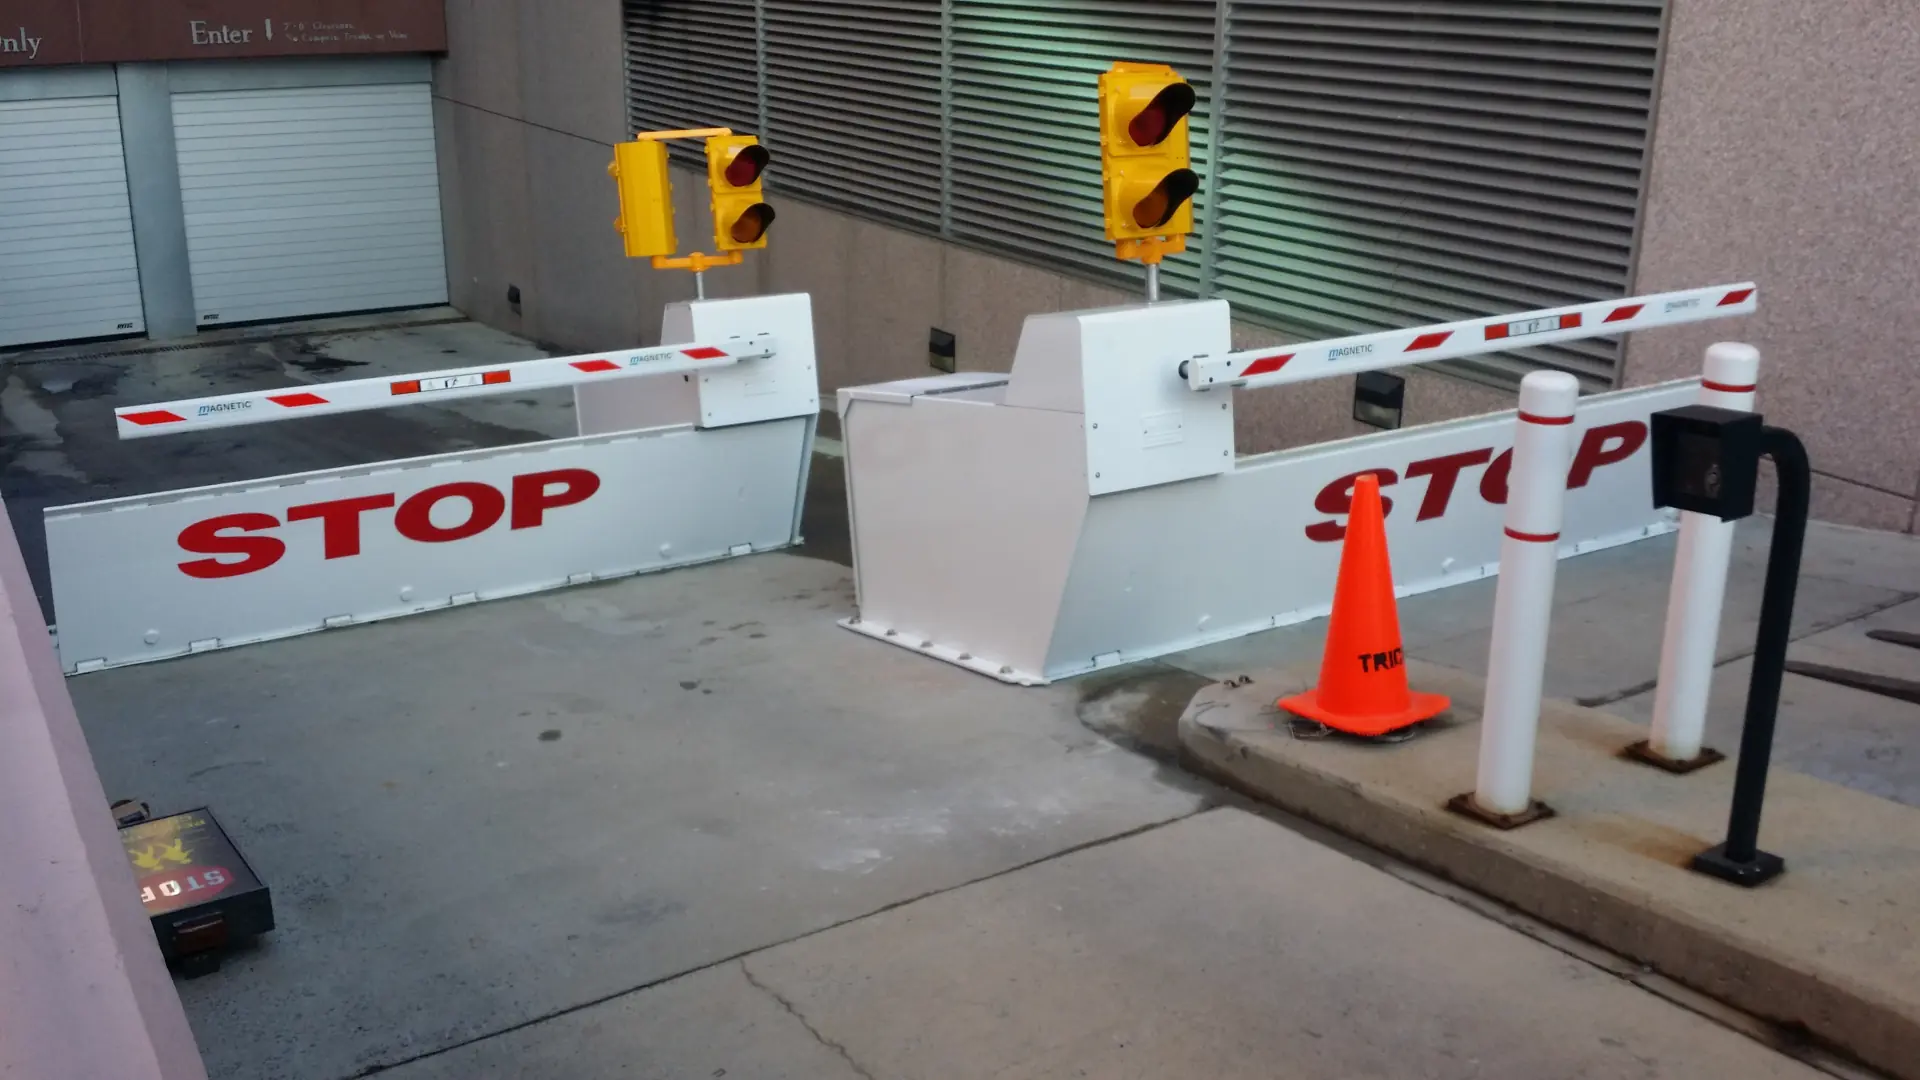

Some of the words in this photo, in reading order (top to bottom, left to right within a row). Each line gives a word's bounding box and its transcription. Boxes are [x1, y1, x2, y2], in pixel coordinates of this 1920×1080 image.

[0, 27, 42, 59] nly
[190, 20, 253, 45] Enter
[177, 468, 601, 579] STOP
